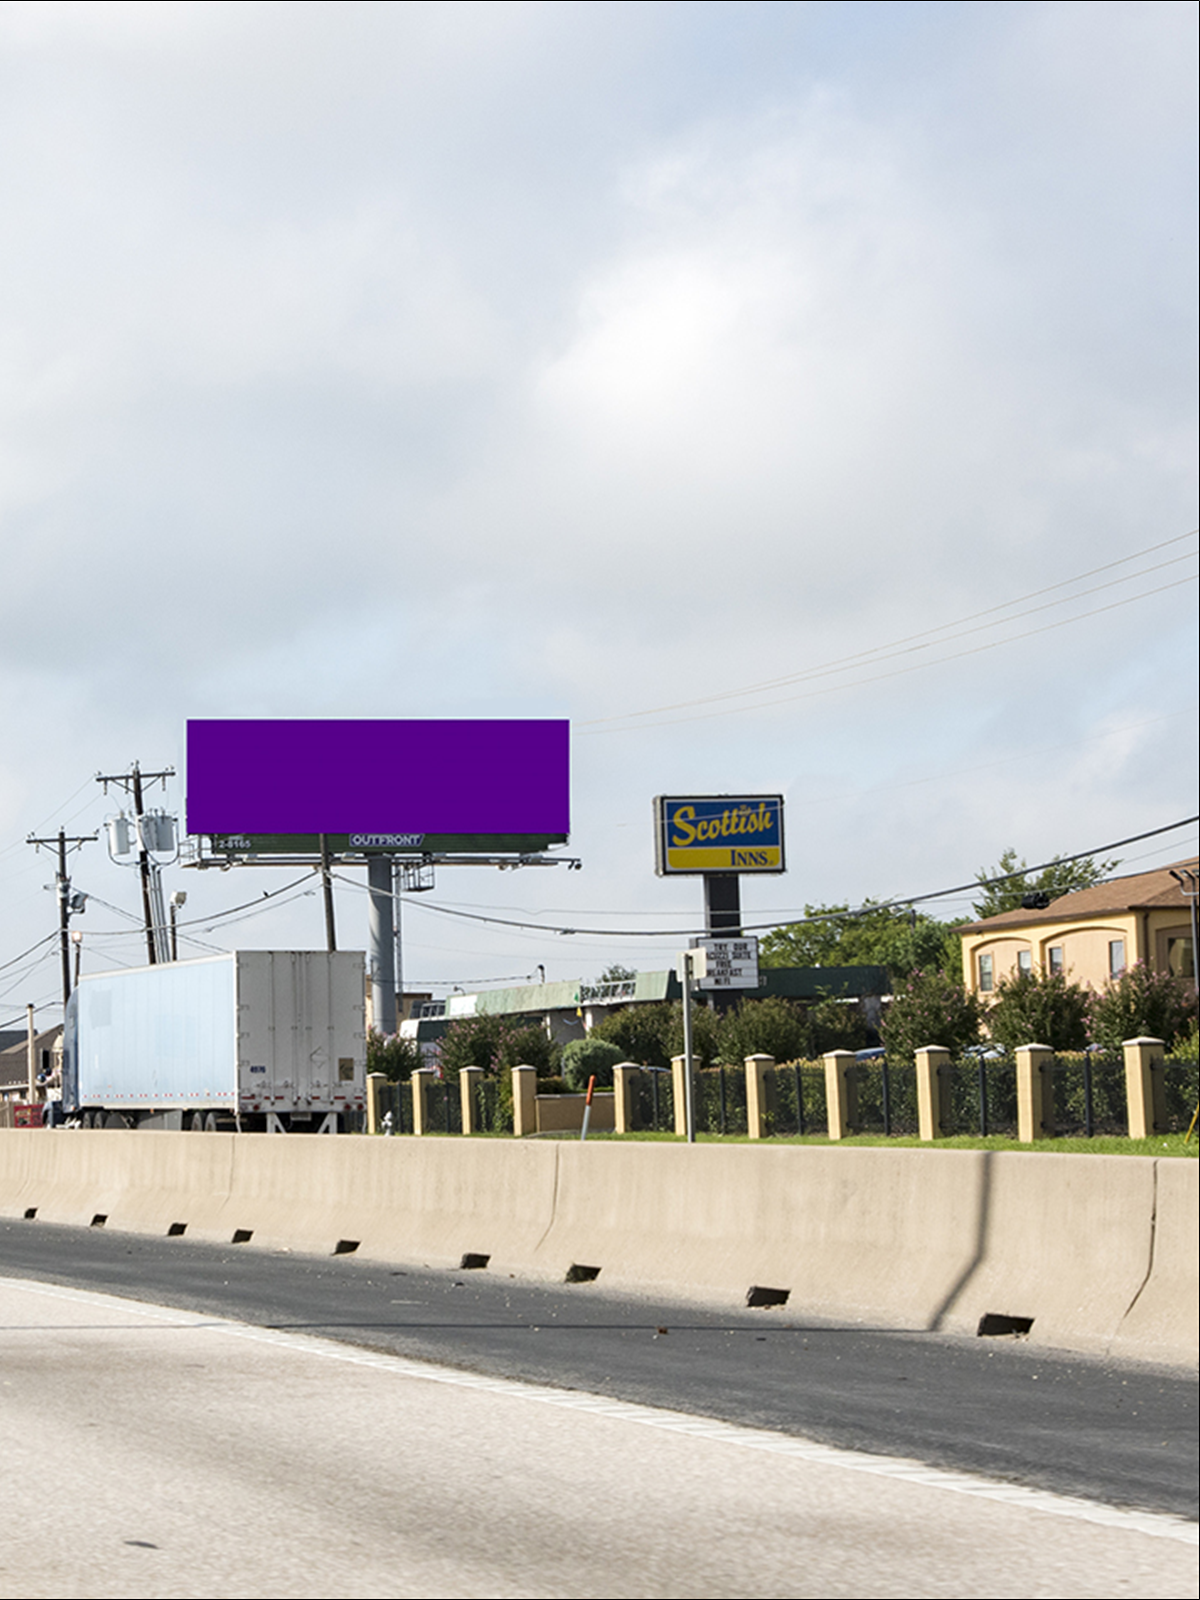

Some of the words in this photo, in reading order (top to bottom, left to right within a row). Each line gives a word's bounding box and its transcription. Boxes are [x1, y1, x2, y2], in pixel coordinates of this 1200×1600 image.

[671, 803, 774, 847] Scottish
[351, 834, 421, 846] OUTFRONT
[730, 849, 769, 867] INNS
[714, 942, 728, 950] TRY
[733, 942, 748, 950] OUR
[715, 960, 732, 968] FREE
